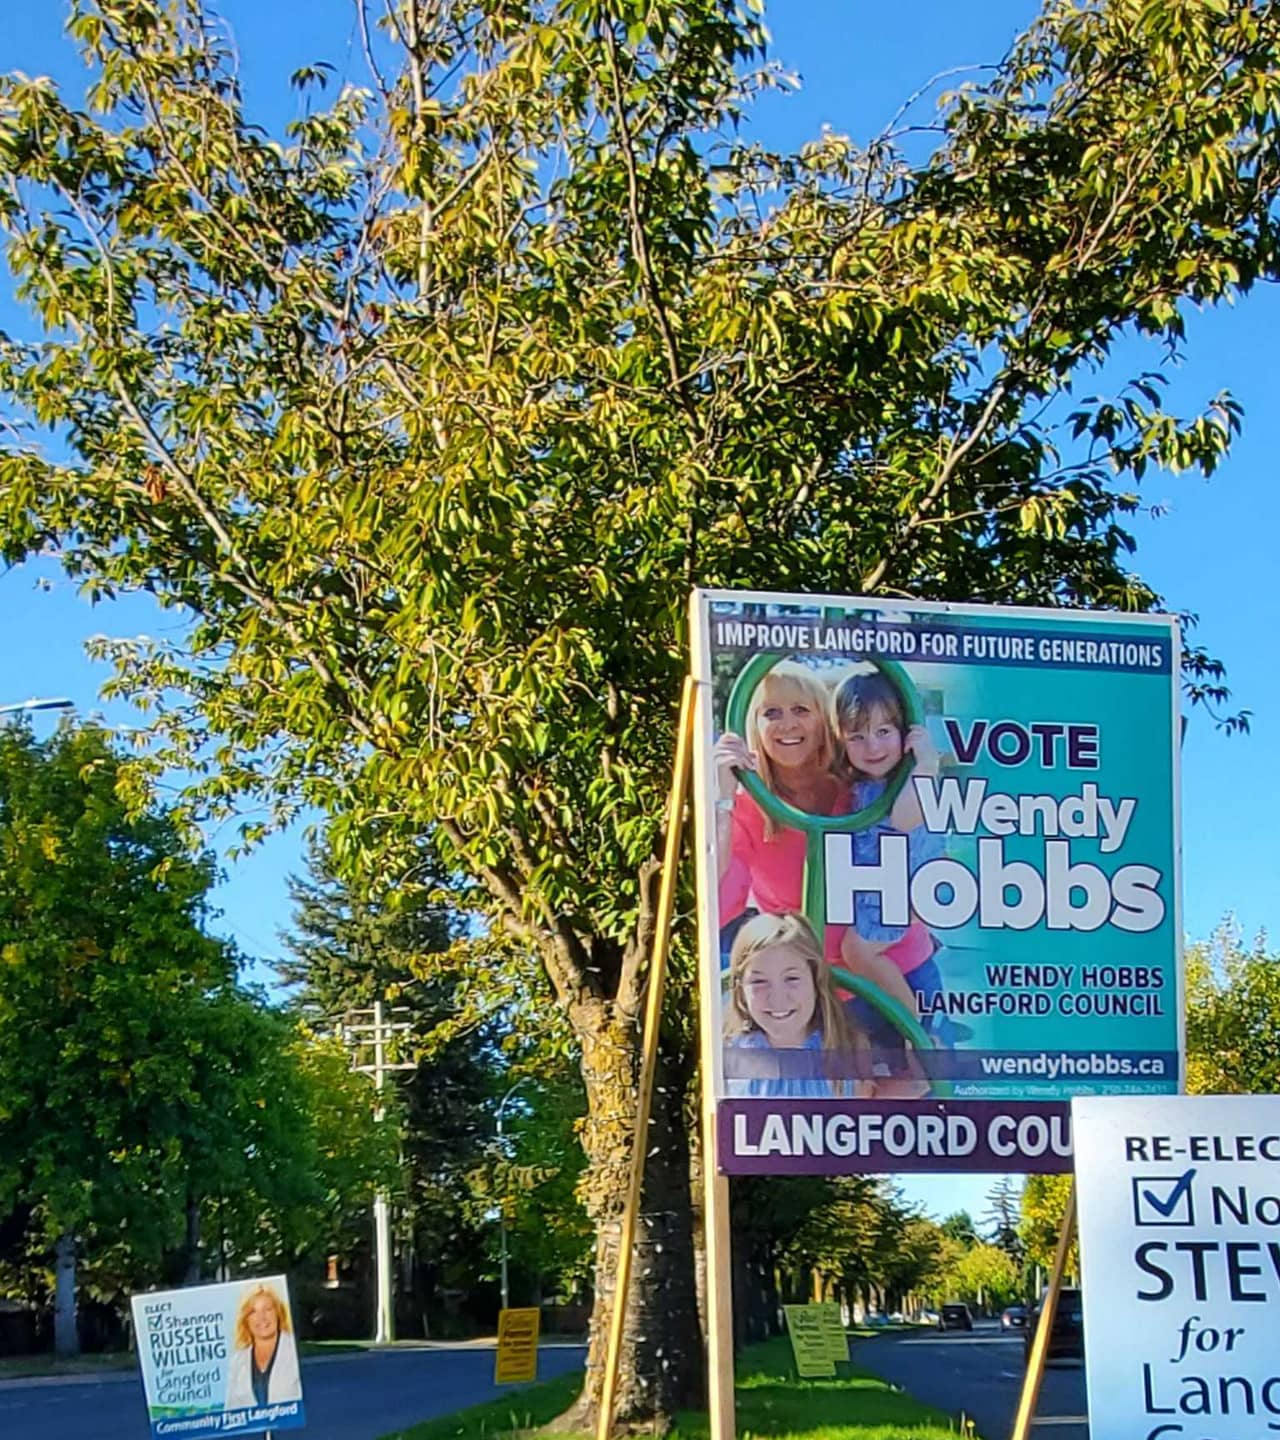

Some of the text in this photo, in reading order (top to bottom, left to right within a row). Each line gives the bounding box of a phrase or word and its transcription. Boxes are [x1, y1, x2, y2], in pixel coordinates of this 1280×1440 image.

[717, 623, 1164, 668] IMPROVE LANGFORD FOR FUTURE GENERATIONS
[944, 720, 1101, 769] VOTE
[913, 776, 1136, 853] Wendy
[824, 833, 1165, 932] Hobbs
[985, 964, 1164, 990] WENDY HOBBS
[917, 991, 1164, 1017] LANGFORD COUNCIL
[980, 1053, 1165, 1080] wendyhobbs.ca
[734, 1113, 1074, 1156] LANGFORD COU
[145, 1303, 172, 1314] ELECT
[166, 1313, 224, 1329] Shannon
[150, 1324, 225, 1350] RUSSELL
[1172, 1316, 1244, 1363] for
[152, 1342, 227, 1368] WILLING
[156, 1367, 221, 1391] Langford
[158, 1385, 212, 1405] Council
[157, 1415, 220, 1434] Community
[223, 1410, 248, 1426] First
[249, 1403, 298, 1421] Langford
